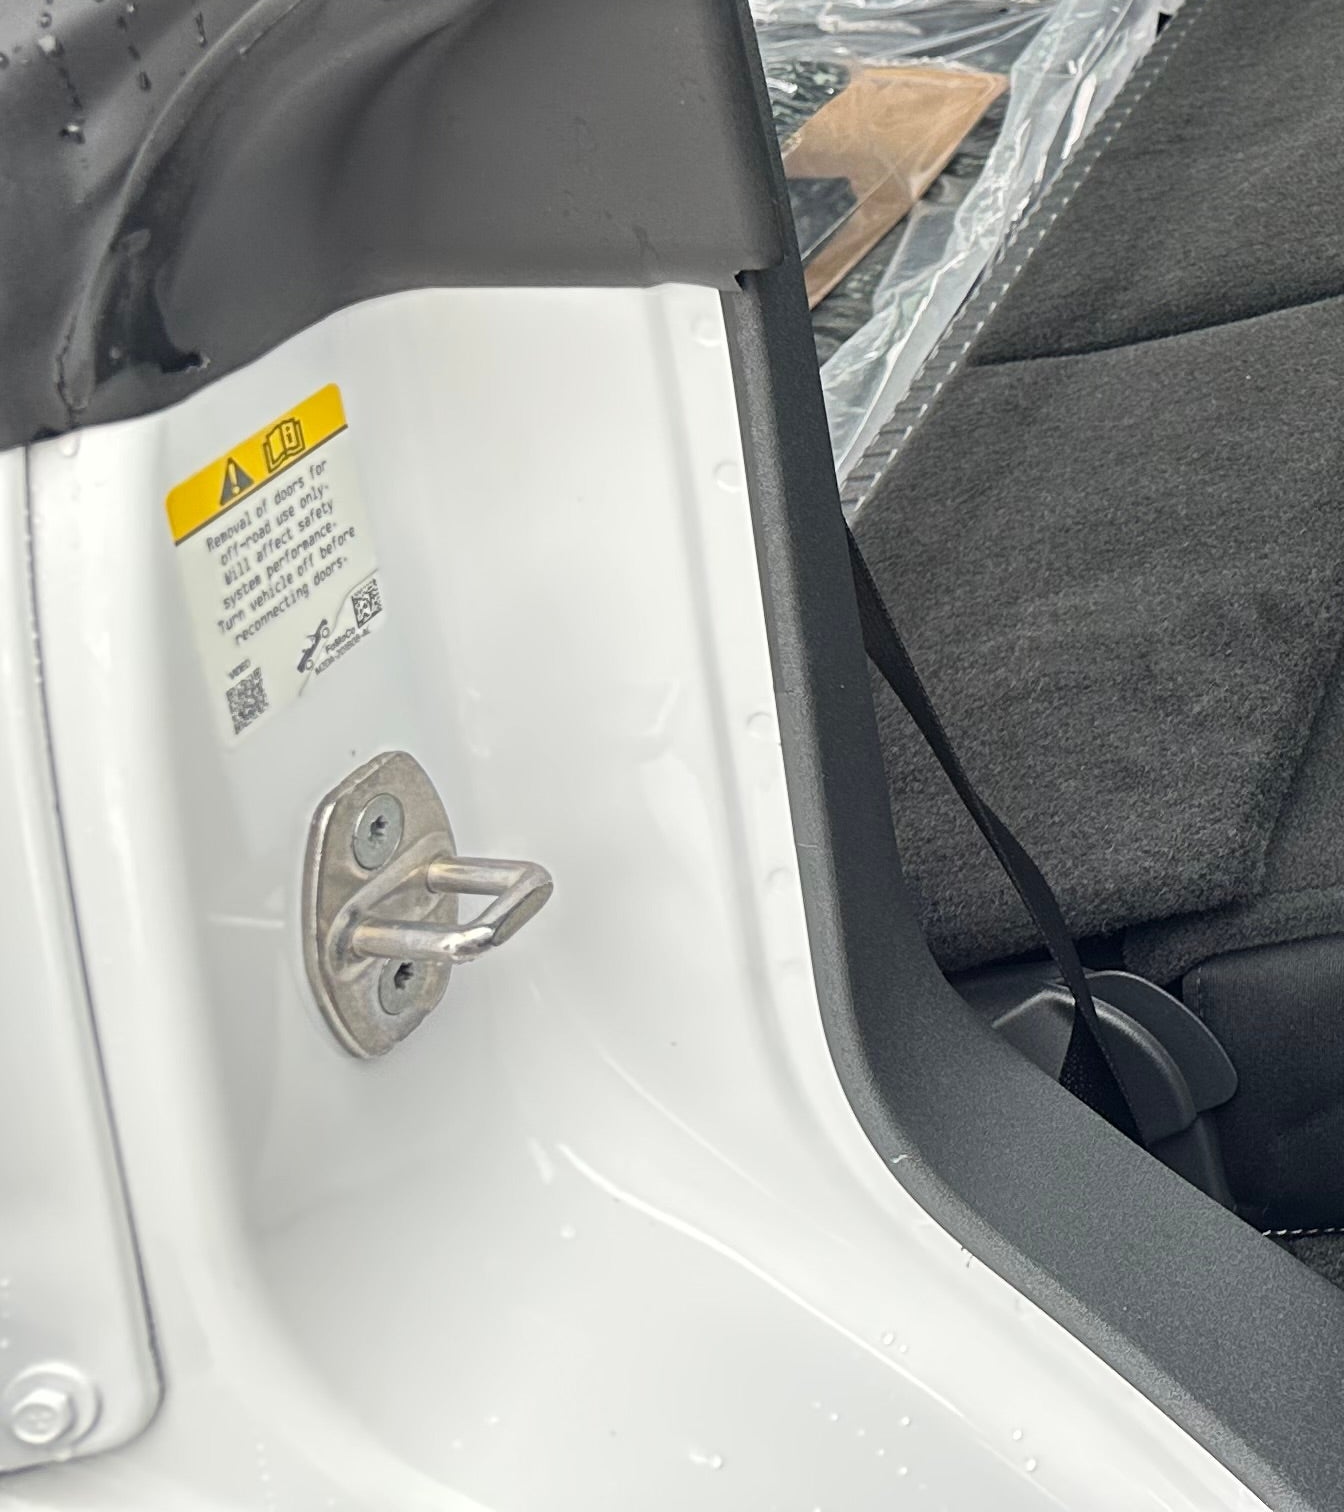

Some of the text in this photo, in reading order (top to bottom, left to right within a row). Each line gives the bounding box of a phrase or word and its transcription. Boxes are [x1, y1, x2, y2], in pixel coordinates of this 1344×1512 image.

[206, 460, 327, 552] Removal of doors for
[220, 484, 329, 566] off-road use only.
[224, 499, 333, 585] Will affect safety
[217, 526, 356, 635] Turn vehicle off before
[223, 521, 337, 610] system performance.
[235, 556, 348, 646] reconnecting doors.
